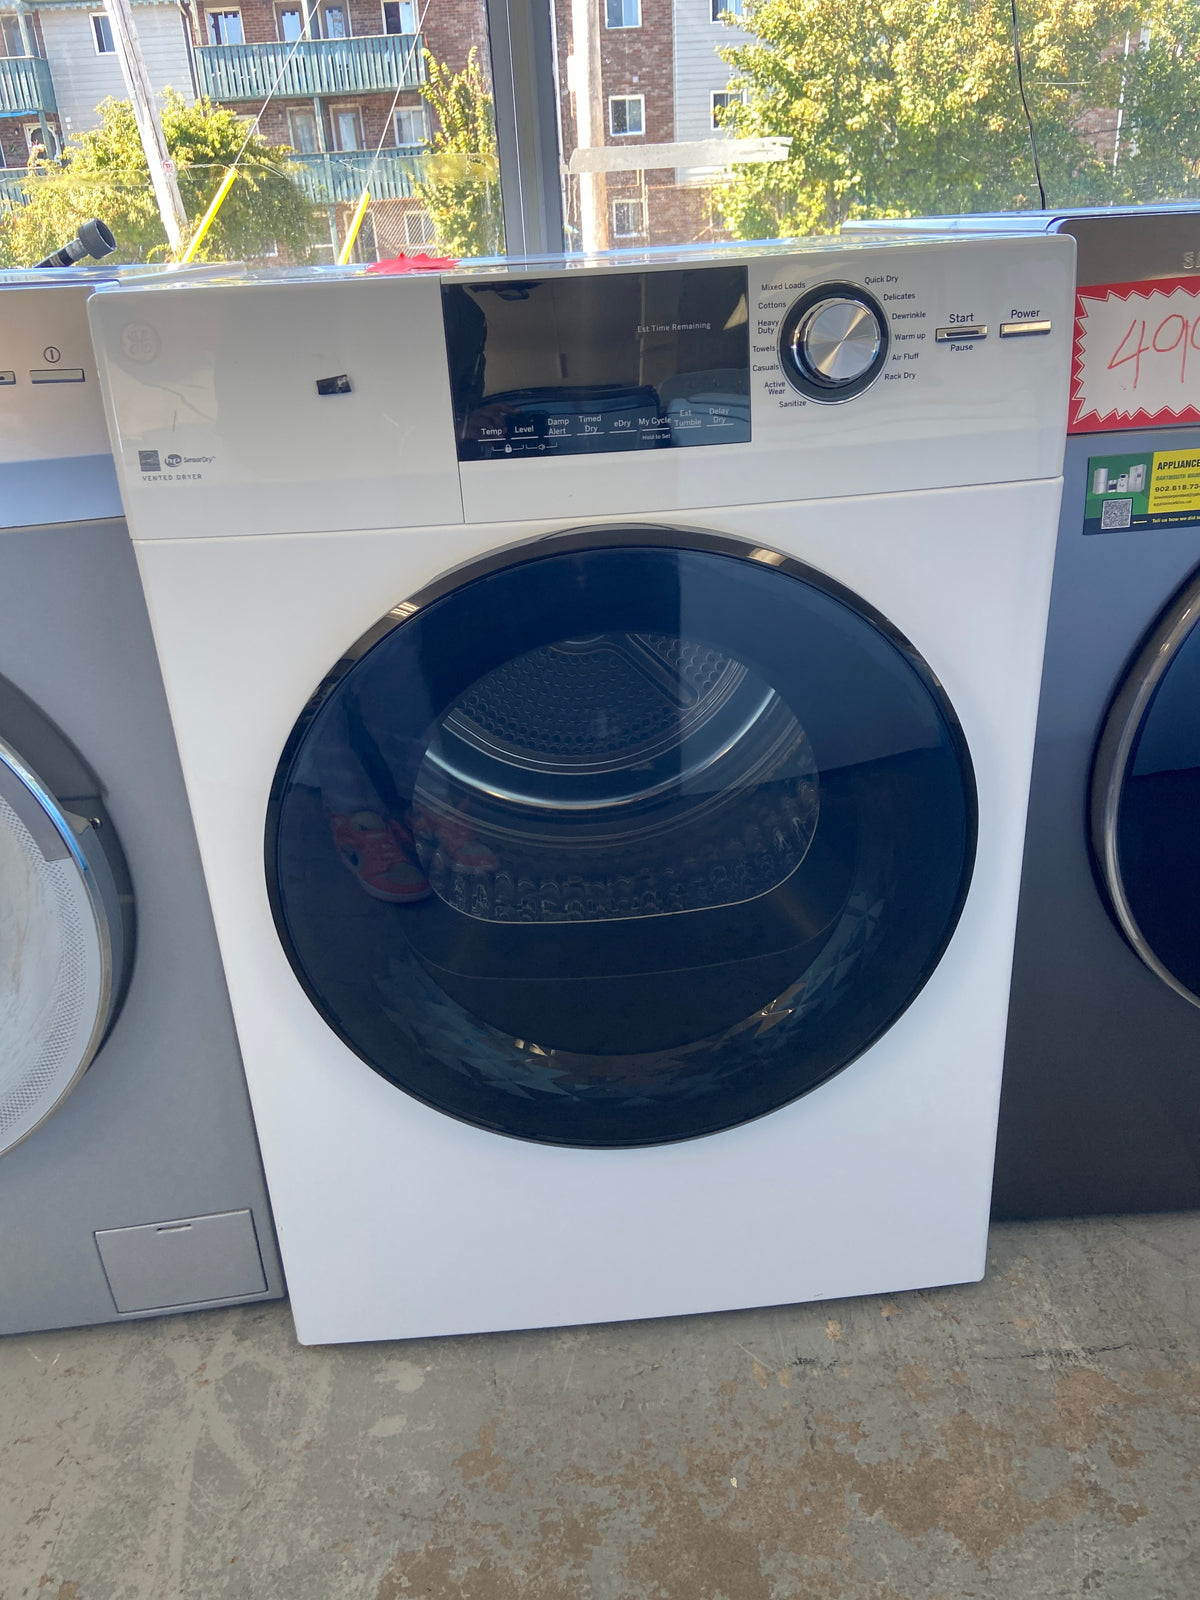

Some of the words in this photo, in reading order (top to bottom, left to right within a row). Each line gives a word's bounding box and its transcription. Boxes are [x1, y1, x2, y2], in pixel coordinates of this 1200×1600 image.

[864, 275, 885, 285] Quick
[886, 274, 899, 284] Dry
[761, 283, 783, 291] Mixed
[784, 281, 806, 290] Loads
[883, 292, 916, 301] Delicates
[758, 301, 787, 310] Cottons
[891, 311, 927, 320] Dewrinkle
[949, 313, 974, 323] Start
[1010, 309, 1041, 319] Power
[637, 325, 650, 333] Est
[651, 324, 670, 332] Time
[671, 322, 711, 331] Remaining
[757, 319, 780, 327] Heavy
[757, 327, 775, 335] Duty
[894, 333, 916, 341] Warm
[916, 333, 926, 341] up
[752, 345, 776, 353] Towels
[950, 343, 974, 352] Pause
[903, 352, 919, 360] Fluff
[752, 363, 780, 372] Casuals
[884, 373, 902, 381] Rack
[903, 371, 917, 380] Dry
[764, 380, 786, 388] Active
[778, 400, 807, 408] Sanitize
[680, 409, 692, 417] Ext
[709, 407, 729, 416] Delay
[547, 418, 570, 427] Damp
[578, 415, 602, 423] Timed
[613, 419, 632, 428] eDry
[638, 418, 649, 426] My
[651, 416, 672, 425] Cycle
[674, 418, 702, 427] Tumble
[713, 416, 727, 424] Dry
[481, 428, 503, 437] Temp
[514, 425, 534, 433] Level
[548, 427, 567, 435] Alert
[584, 425, 598, 433] Dry
[176, 473, 202, 481] DRYER
